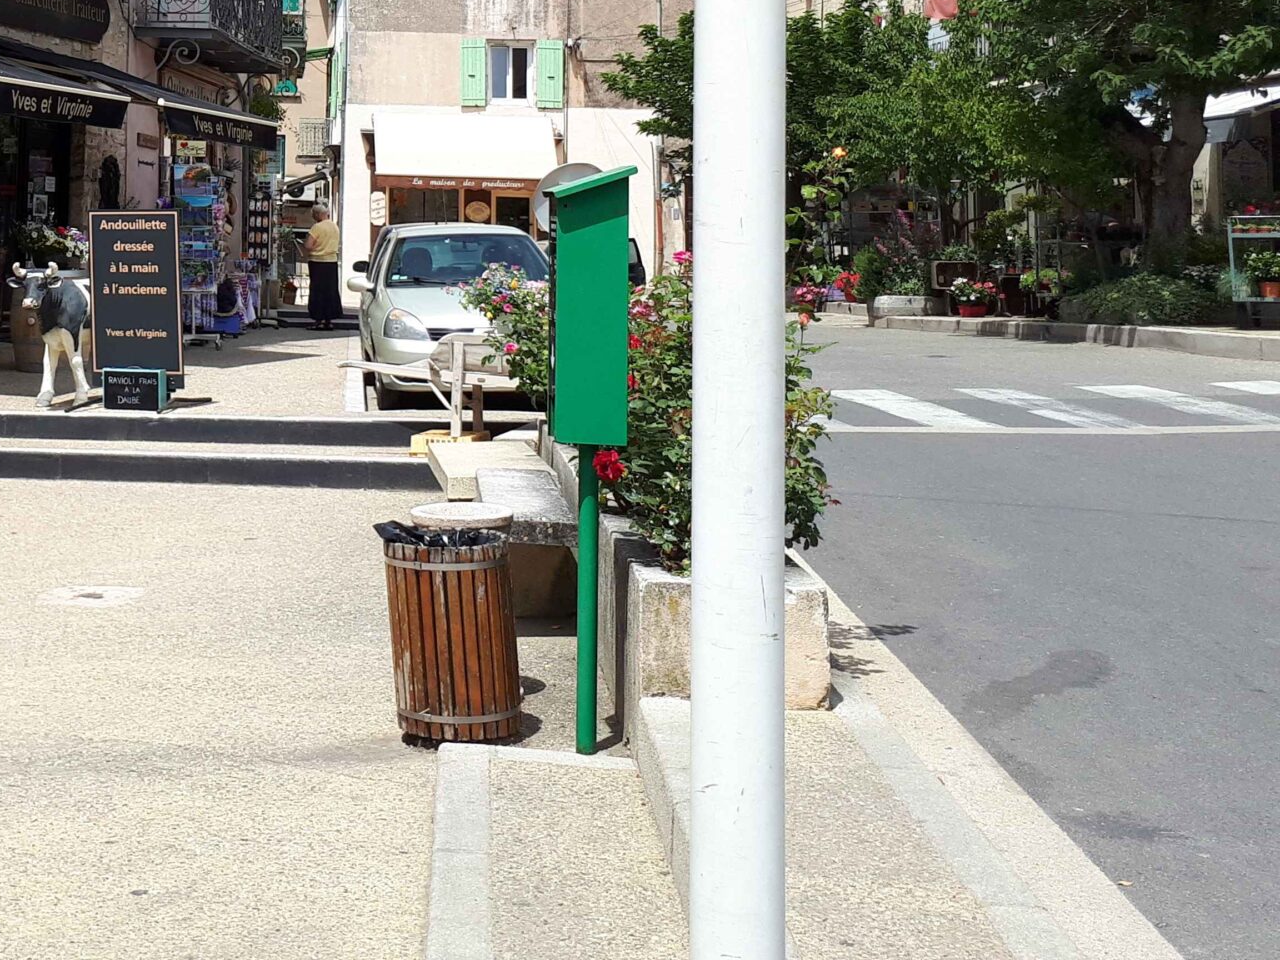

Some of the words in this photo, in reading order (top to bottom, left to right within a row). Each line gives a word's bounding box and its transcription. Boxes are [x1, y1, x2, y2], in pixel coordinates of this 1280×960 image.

[11, 89, 37, 112] Yves
[40, 97, 52, 114] et
[56, 95, 93, 120] Virginie
[192, 114, 214, 135] Yves
[216, 122, 224, 136] et
[226, 122, 253, 144] Virginie
[411, 177, 423, 185] La
[429, 178, 455, 186] maison
[481, 180, 524, 188] producteurs
[99, 219, 167, 230] Andouillette
[113, 240, 154, 252] dressée
[110, 262, 117, 273] à
[119, 262, 128, 273] la
[131, 262, 159, 273] main
[103, 283, 109, 294] à
[112, 283, 168, 295] l'ancienne
[105, 328, 124, 337] Yves
[125, 329, 134, 337] et
[135, 328, 168, 339] Virginie
[117, 395, 141, 404] DAUBE
